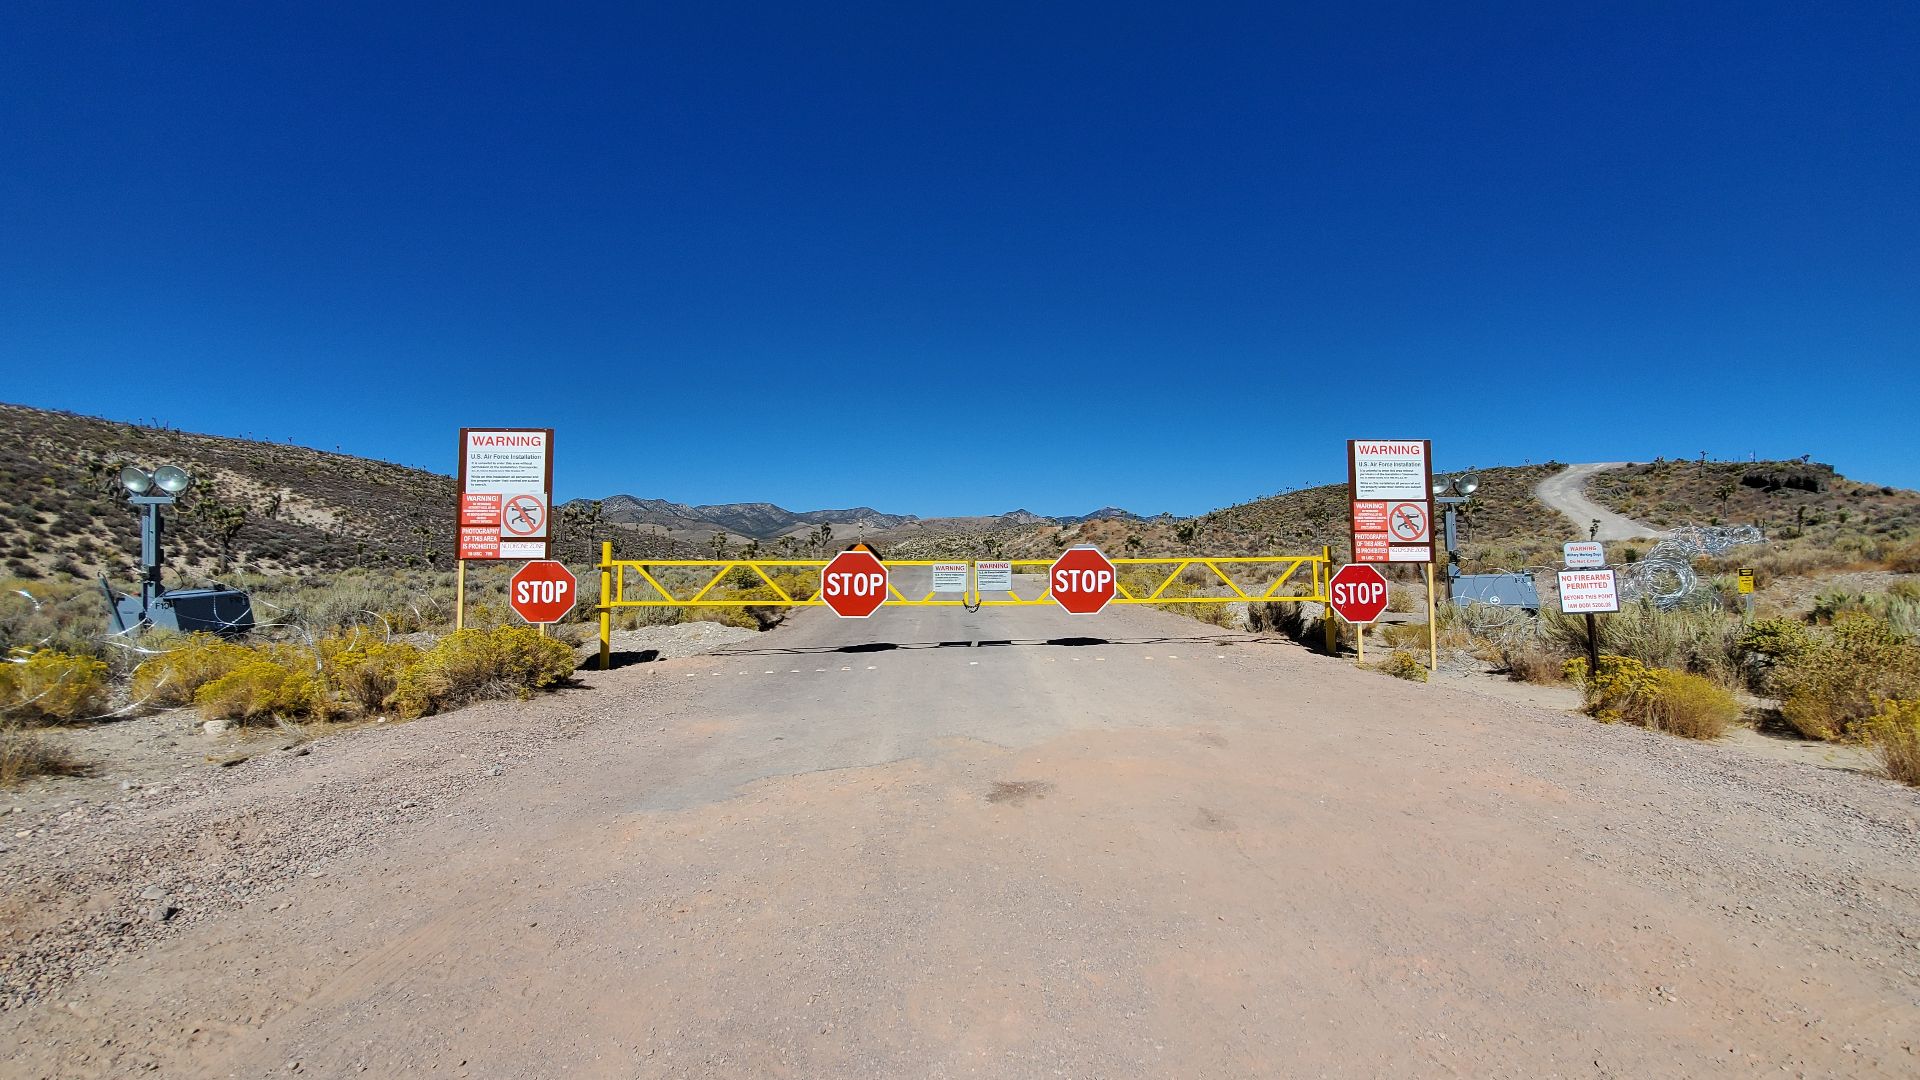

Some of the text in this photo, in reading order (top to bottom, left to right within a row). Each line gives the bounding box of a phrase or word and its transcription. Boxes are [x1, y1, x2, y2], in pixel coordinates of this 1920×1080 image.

[472, 436, 541, 446] WARNING
[1359, 446, 1420, 454] WARNING
[827, 573, 883, 596] STOP
[1055, 570, 1111, 592] STOP
[517, 581, 567, 603] STOP
[1335, 583, 1383, 604] STOP
